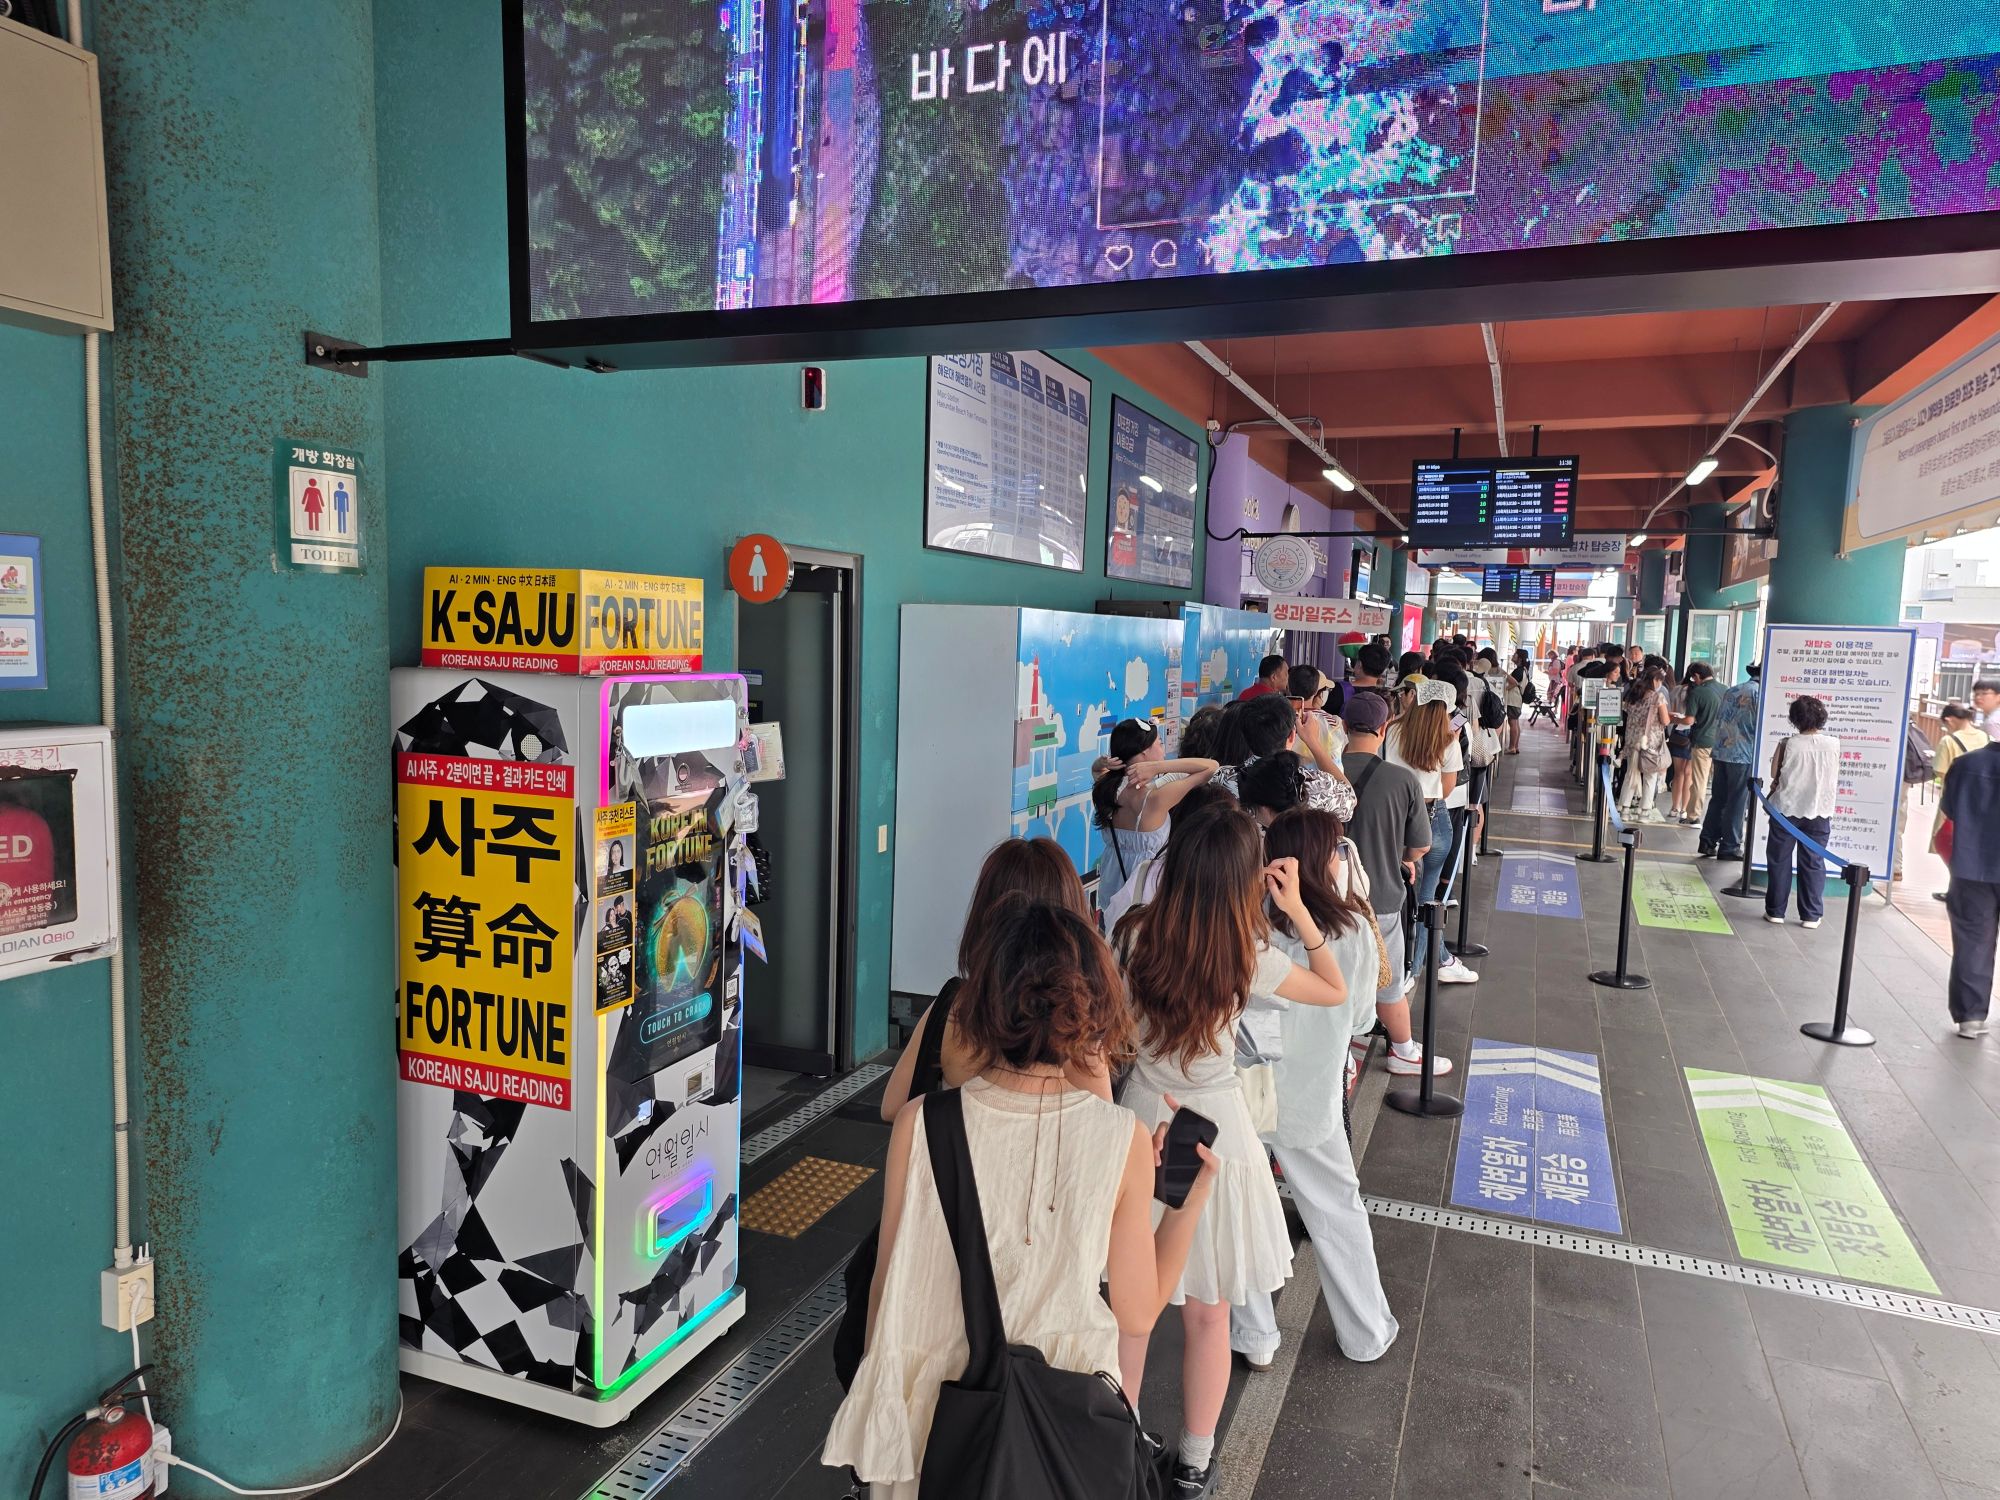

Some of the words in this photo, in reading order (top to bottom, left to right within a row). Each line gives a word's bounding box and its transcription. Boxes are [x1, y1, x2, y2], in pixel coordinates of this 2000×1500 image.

[911, 32, 1067, 101] 바다에
[292, 447, 319, 464] 개방
[322, 451, 355, 469] 화장실
[300, 548, 353, 563] TOILET
[1591, 540, 1622, 552] 탑승장
[449, 574, 458, 584] AI
[465, 575, 470, 585] 2
[472, 575, 490, 585] MIN
[497, 576, 516, 585] ENG
[519, 574, 533, 587] 中文
[535, 575, 556, 587] 日本語
[605, 579, 613, 589] AI
[618, 580, 623, 589] 2
[624, 580, 639, 591] MIN
[644, 582, 658, 592] ENG
[660, 582, 670, 593] 中文
[431, 589, 575, 648] K-SAJU
[585, 595, 702, 649] FORTUNE
[1274, 603, 1352, 624] 생과일쥬스
[1805, 640, 1833, 649] 재탑승
[1835, 641, 1873, 650] 이용객은
[441, 654, 481, 666] KOREAN
[483, 656, 510, 668] SAJU
[512, 657, 559, 669] READING
[600, 660, 633, 671] KOREAN
[635, 660, 656, 671] SAJU
[657, 659, 689, 670] READING
[1804, 668, 1827, 676] 해운대
[1829, 669, 1869, 677] 해변열차는
[1780, 676, 1811, 684] 입석으로
[1857, 679, 1892, 687] 있습니다.
[1835, 695, 1883, 703] passengers
[406, 760, 417, 777] AI
[419, 759, 438, 780] 사주
[446, 762, 481, 785] 2분이면
[484, 765, 493, 786] 끝
[502, 766, 522, 788] 결과
[524, 768, 545, 790] 카드
[546, 770, 566, 792] 인쇄
[597, 810, 608, 826] 사주
[609, 808, 619, 824] 추천
[620, 806, 635, 821] 리스트
[650, 808, 708, 845] KOREAN
[412, 797, 560, 883] 사주
[646, 834, 713, 881] FORTUNE
[13, 893, 52, 904] emergency
[23, 880, 67, 894] 사용하세요!
[0, 936, 40, 954] DIAN
[412, 890, 560, 980] 算命
[406, 980, 566, 1066] FORTUNE
[648, 1016, 671, 1036] TOUCH
[674, 1010, 683, 1024] TO
[408, 1057, 461, 1086] KOREAN
[464, 1067, 500, 1093] SAJU
[502, 1073, 564, 1106] READING
[1489, 1086, 1514, 1126] Reboarding
[1727, 1111, 1754, 1147] Boarding
[646, 1115, 709, 1180] 연월일시
[1739, 1147, 1760, 1165] First
[1479, 1136, 1528, 1201] 해변열차
[1540, 1153, 1590, 1205] 재탑승
[1742, 1178, 1817, 1255] 해변열차
[1815, 1198, 1891, 1258] 첫탑승
